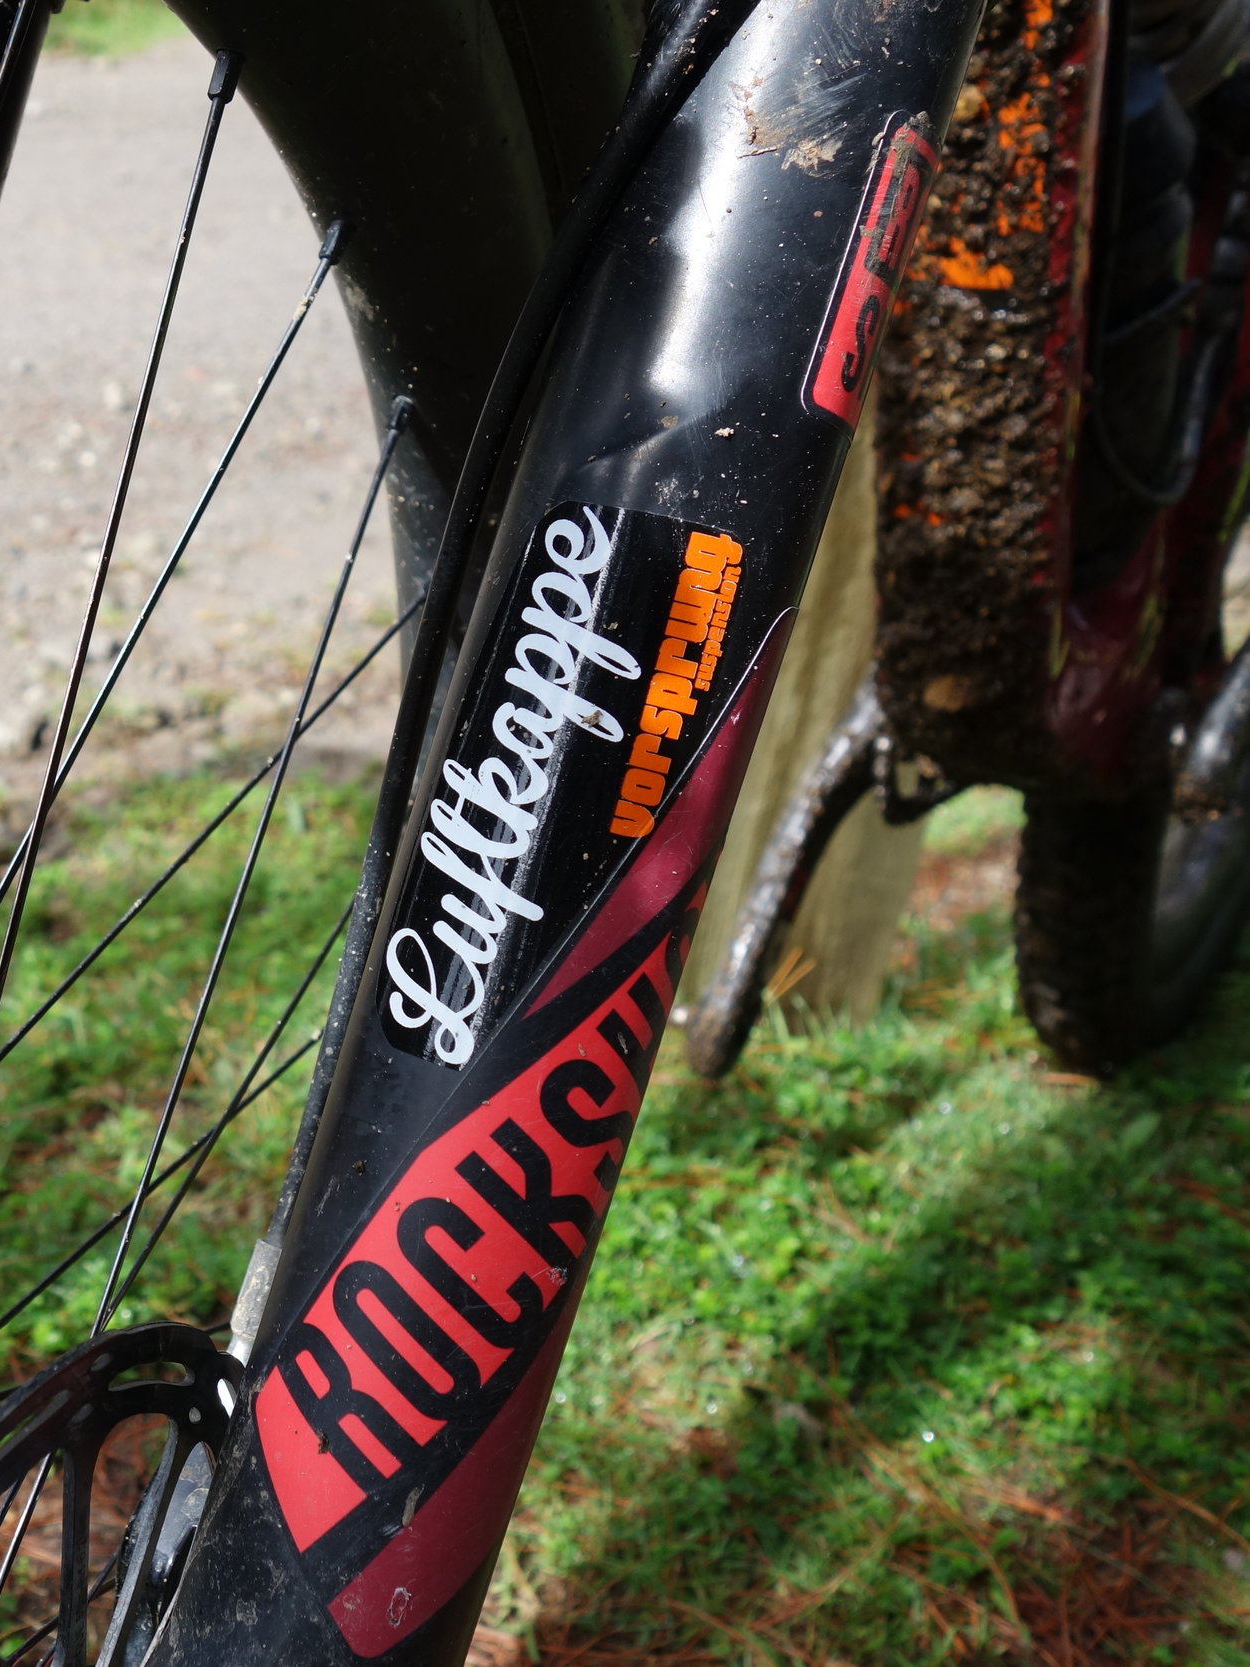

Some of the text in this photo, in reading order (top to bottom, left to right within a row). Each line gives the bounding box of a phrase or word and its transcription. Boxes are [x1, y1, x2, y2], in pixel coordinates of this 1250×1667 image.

[609, 531, 744, 838] vorsprung
[694, 565, 742, 692] suspension
[386, 505, 641, 1065] Luftkappe
